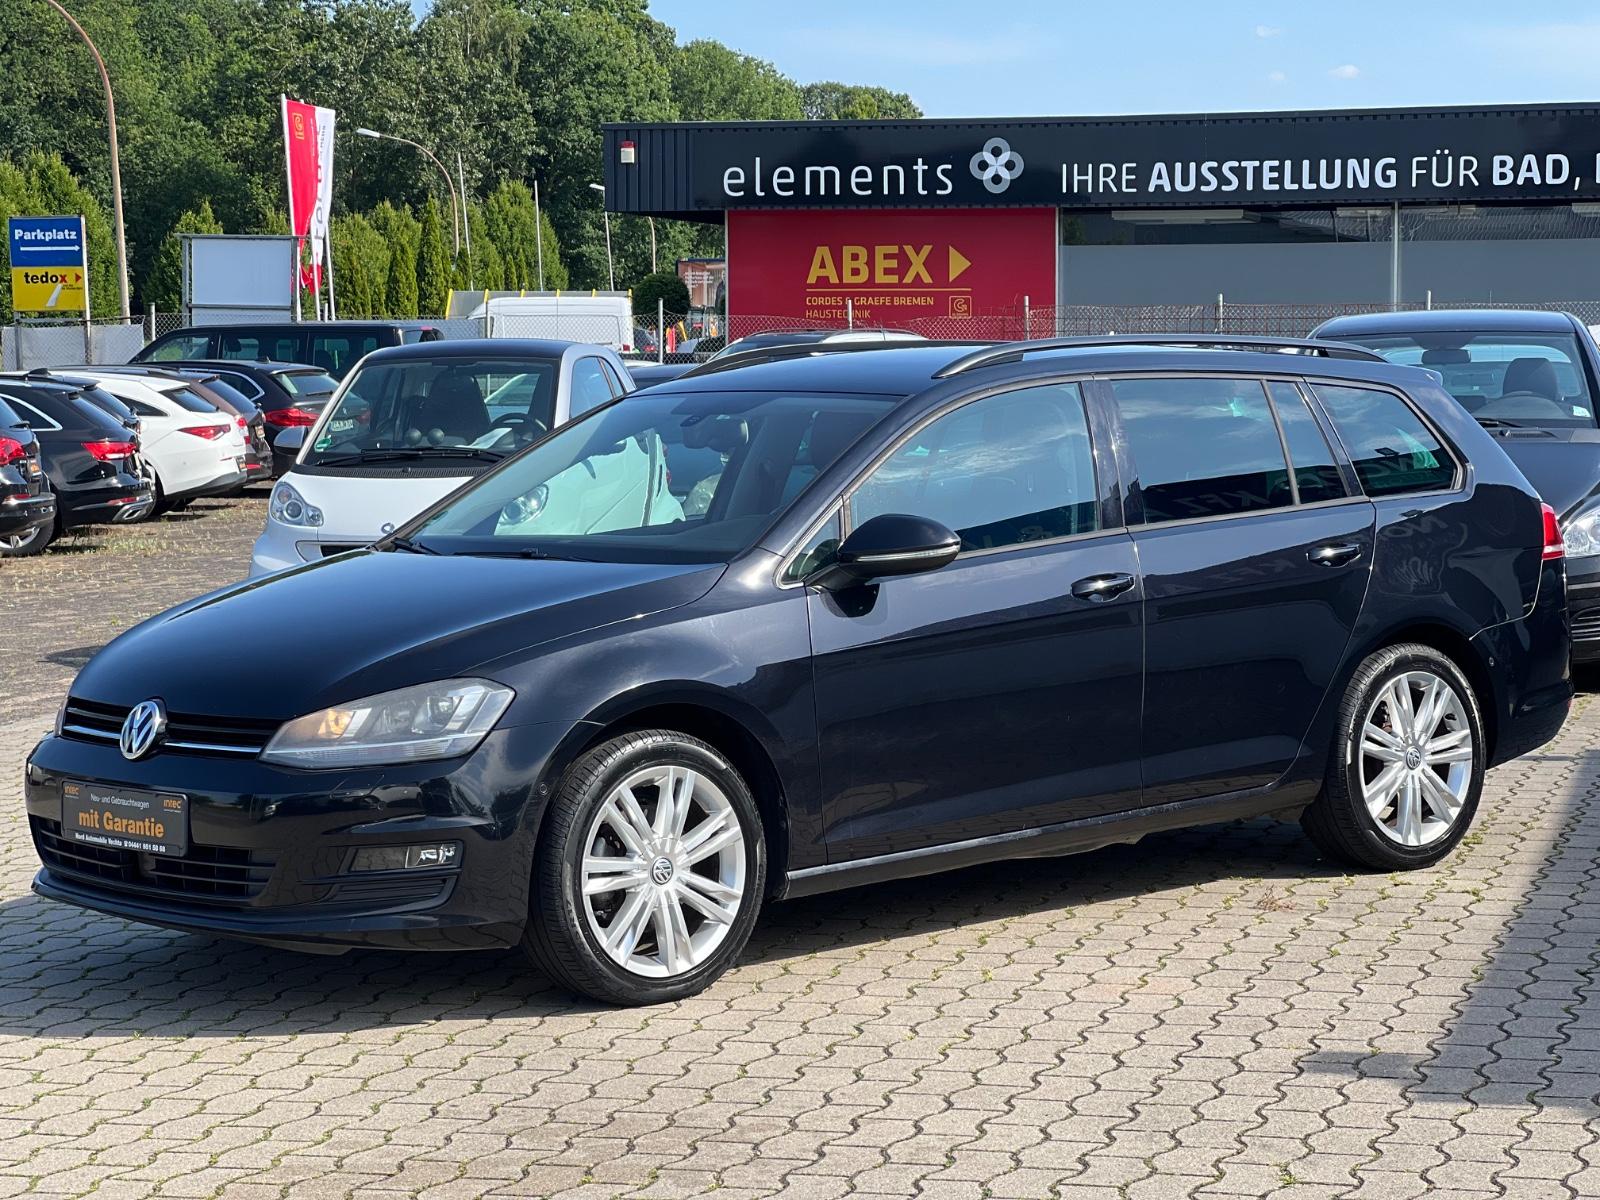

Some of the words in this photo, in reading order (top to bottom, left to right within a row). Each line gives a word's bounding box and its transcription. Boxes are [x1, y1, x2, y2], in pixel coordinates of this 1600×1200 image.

[723, 156, 953, 197] elements
[1062, 162, 1137, 193] IHRE
[1148, 157, 1397, 193] AUSSTELLUNG
[1411, 149, 1479, 188] FÜR
[1493, 153, 1580, 191] BAD,
[14, 228, 77, 241] Parkplatz
[806, 245, 933, 284] ABEX
[24, 271, 68, 284] tedox
[806, 296, 842, 305] CORDES
[854, 296, 891, 305] GRAEFE
[894, 296, 934, 305] BREMEN
[806, 309, 871, 318] HAUSTECNIK
[79, 809, 99, 828] mit
[103, 811, 165, 838] Garantie
